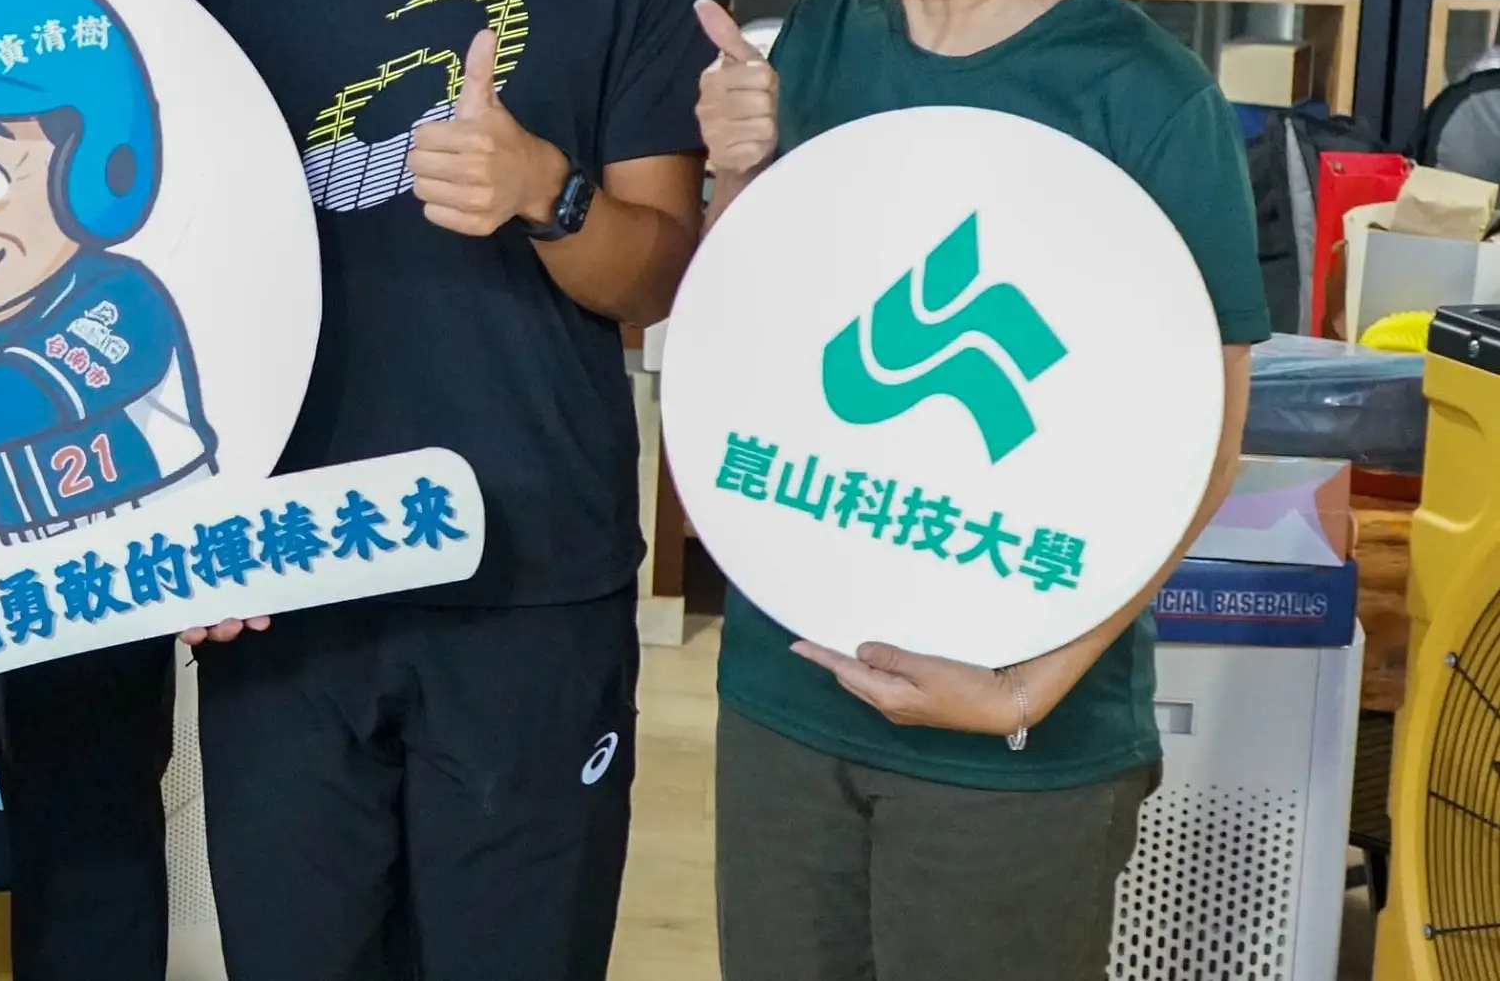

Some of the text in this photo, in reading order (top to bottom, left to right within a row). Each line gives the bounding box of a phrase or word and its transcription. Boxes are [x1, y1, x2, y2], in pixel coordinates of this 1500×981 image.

[46, 333, 111, 389] 台南市
[51, 433, 118, 497] 21
[715, 431, 1088, 593] 崑山科技大學
[1151, 589, 1328, 617] ICIAL BASEBALLS
